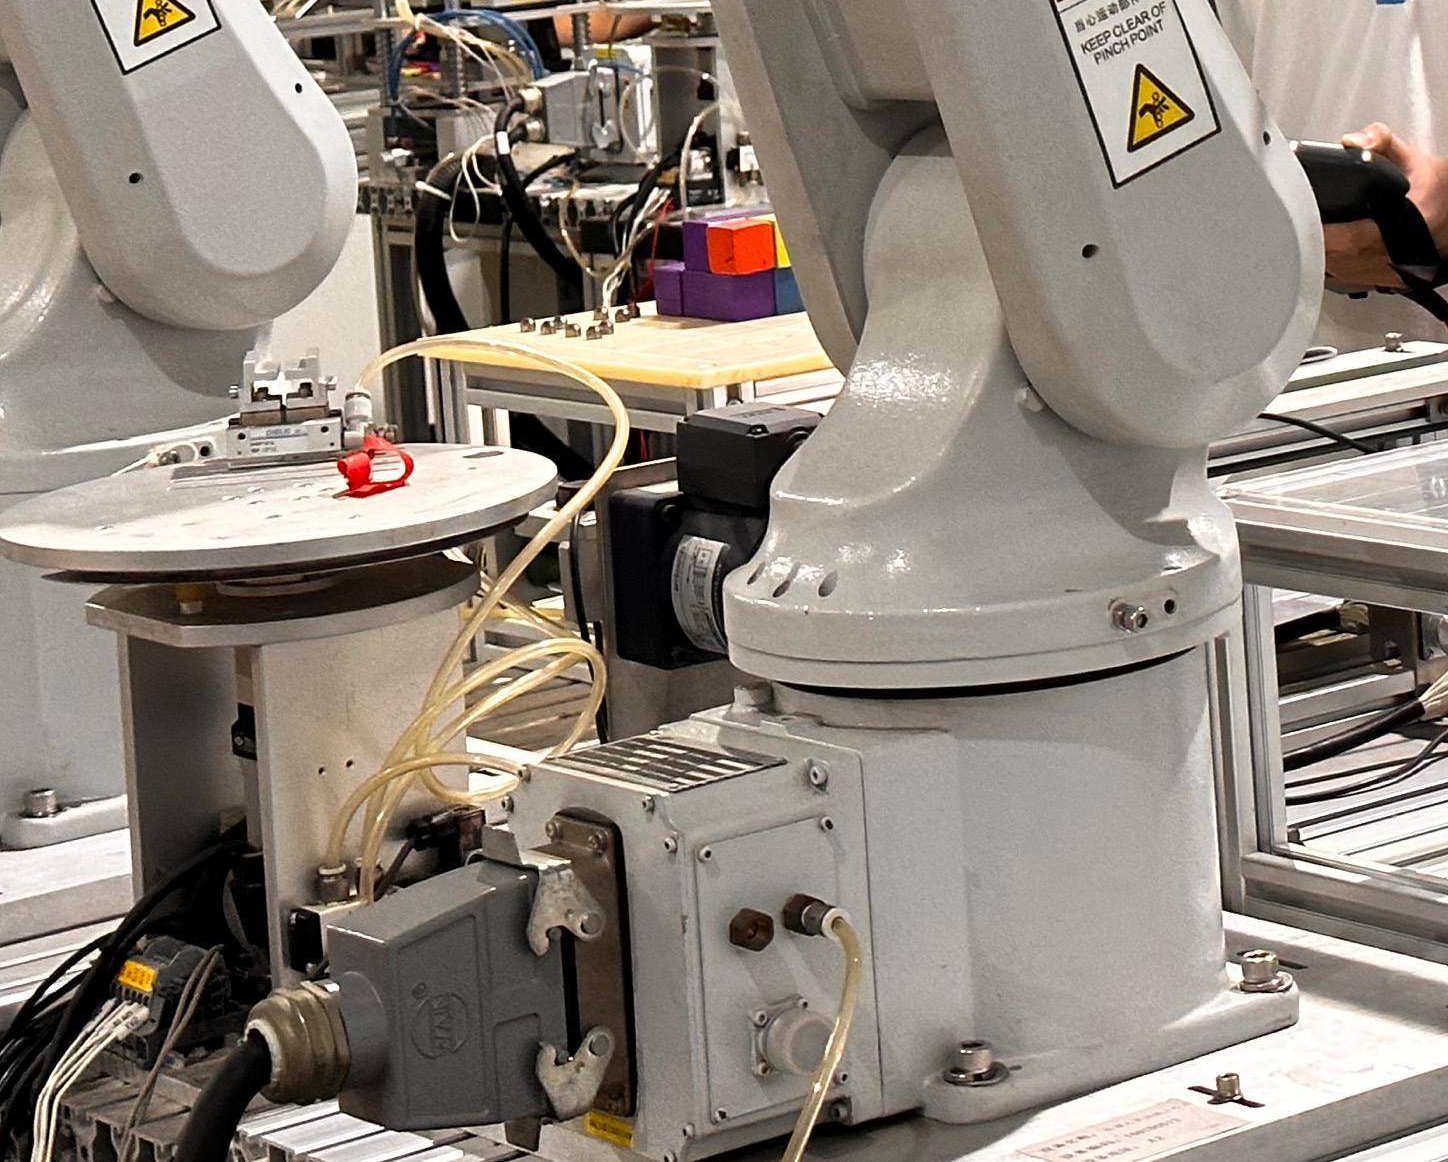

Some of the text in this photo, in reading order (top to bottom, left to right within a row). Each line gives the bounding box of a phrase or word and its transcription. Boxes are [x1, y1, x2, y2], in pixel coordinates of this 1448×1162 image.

[1081, 0, 1166, 54] KEEP CLEAR OF
[1093, 19, 1163, 65] PINCH POINT
